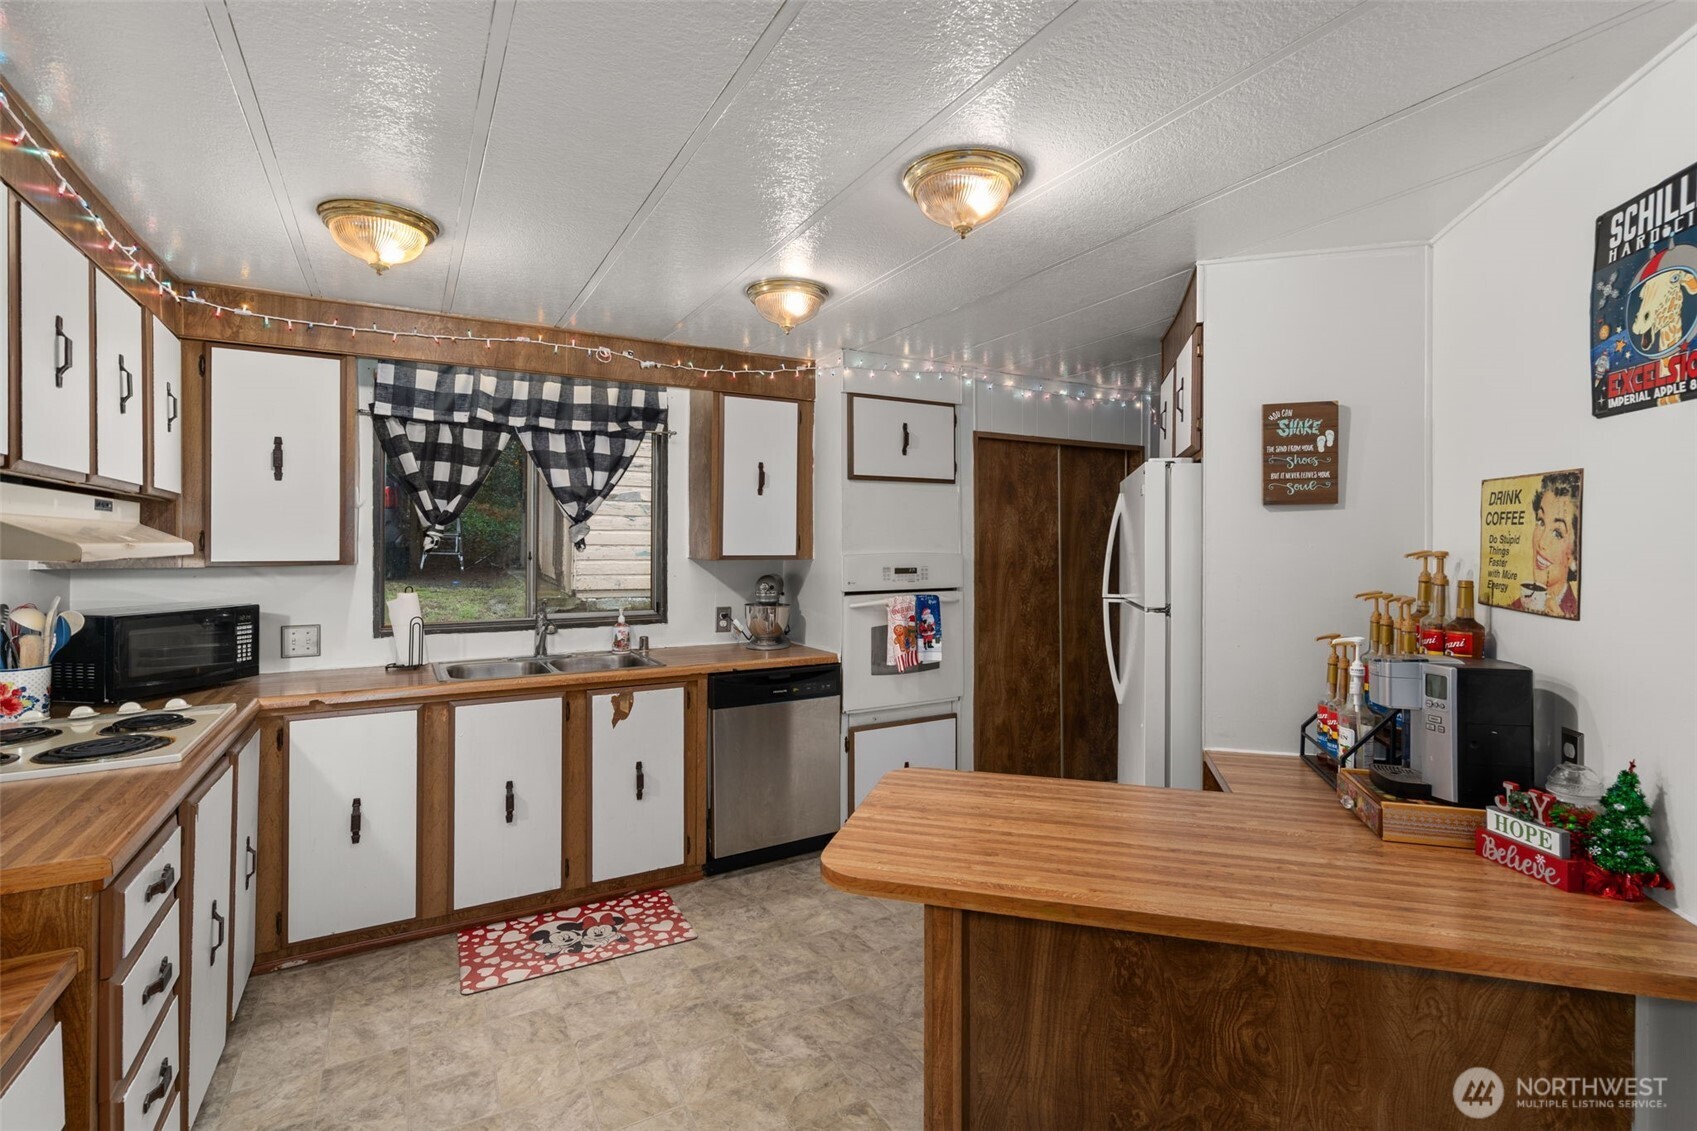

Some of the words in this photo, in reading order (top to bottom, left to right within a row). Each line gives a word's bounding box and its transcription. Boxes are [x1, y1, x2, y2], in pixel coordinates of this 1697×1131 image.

[1609, 174, 1697, 249] SCHILL
[1608, 227, 1660, 264] HARD
[1608, 390, 1651, 409] IMPERIAL
[1653, 381, 1687, 399] APPLE
[1276, 418, 1322, 437] SHAKE
[1488, 489, 1522, 506] DRINK
[1485, 510, 1525, 526] COFFEE
[1489, 534, 1498, 544] Do
[1499, 534, 1521, 547] Stupid
[1489, 545, 1510, 559] Things
[1488, 557, 1508, 568] Faster
[1487, 569, 1501, 579] with
[1501, 569, 1518, 580] More
[1487, 580, 1508, 593] Energy
[1494, 813, 1552, 851] HOPE
[1481, 834, 1561, 885] Believe
